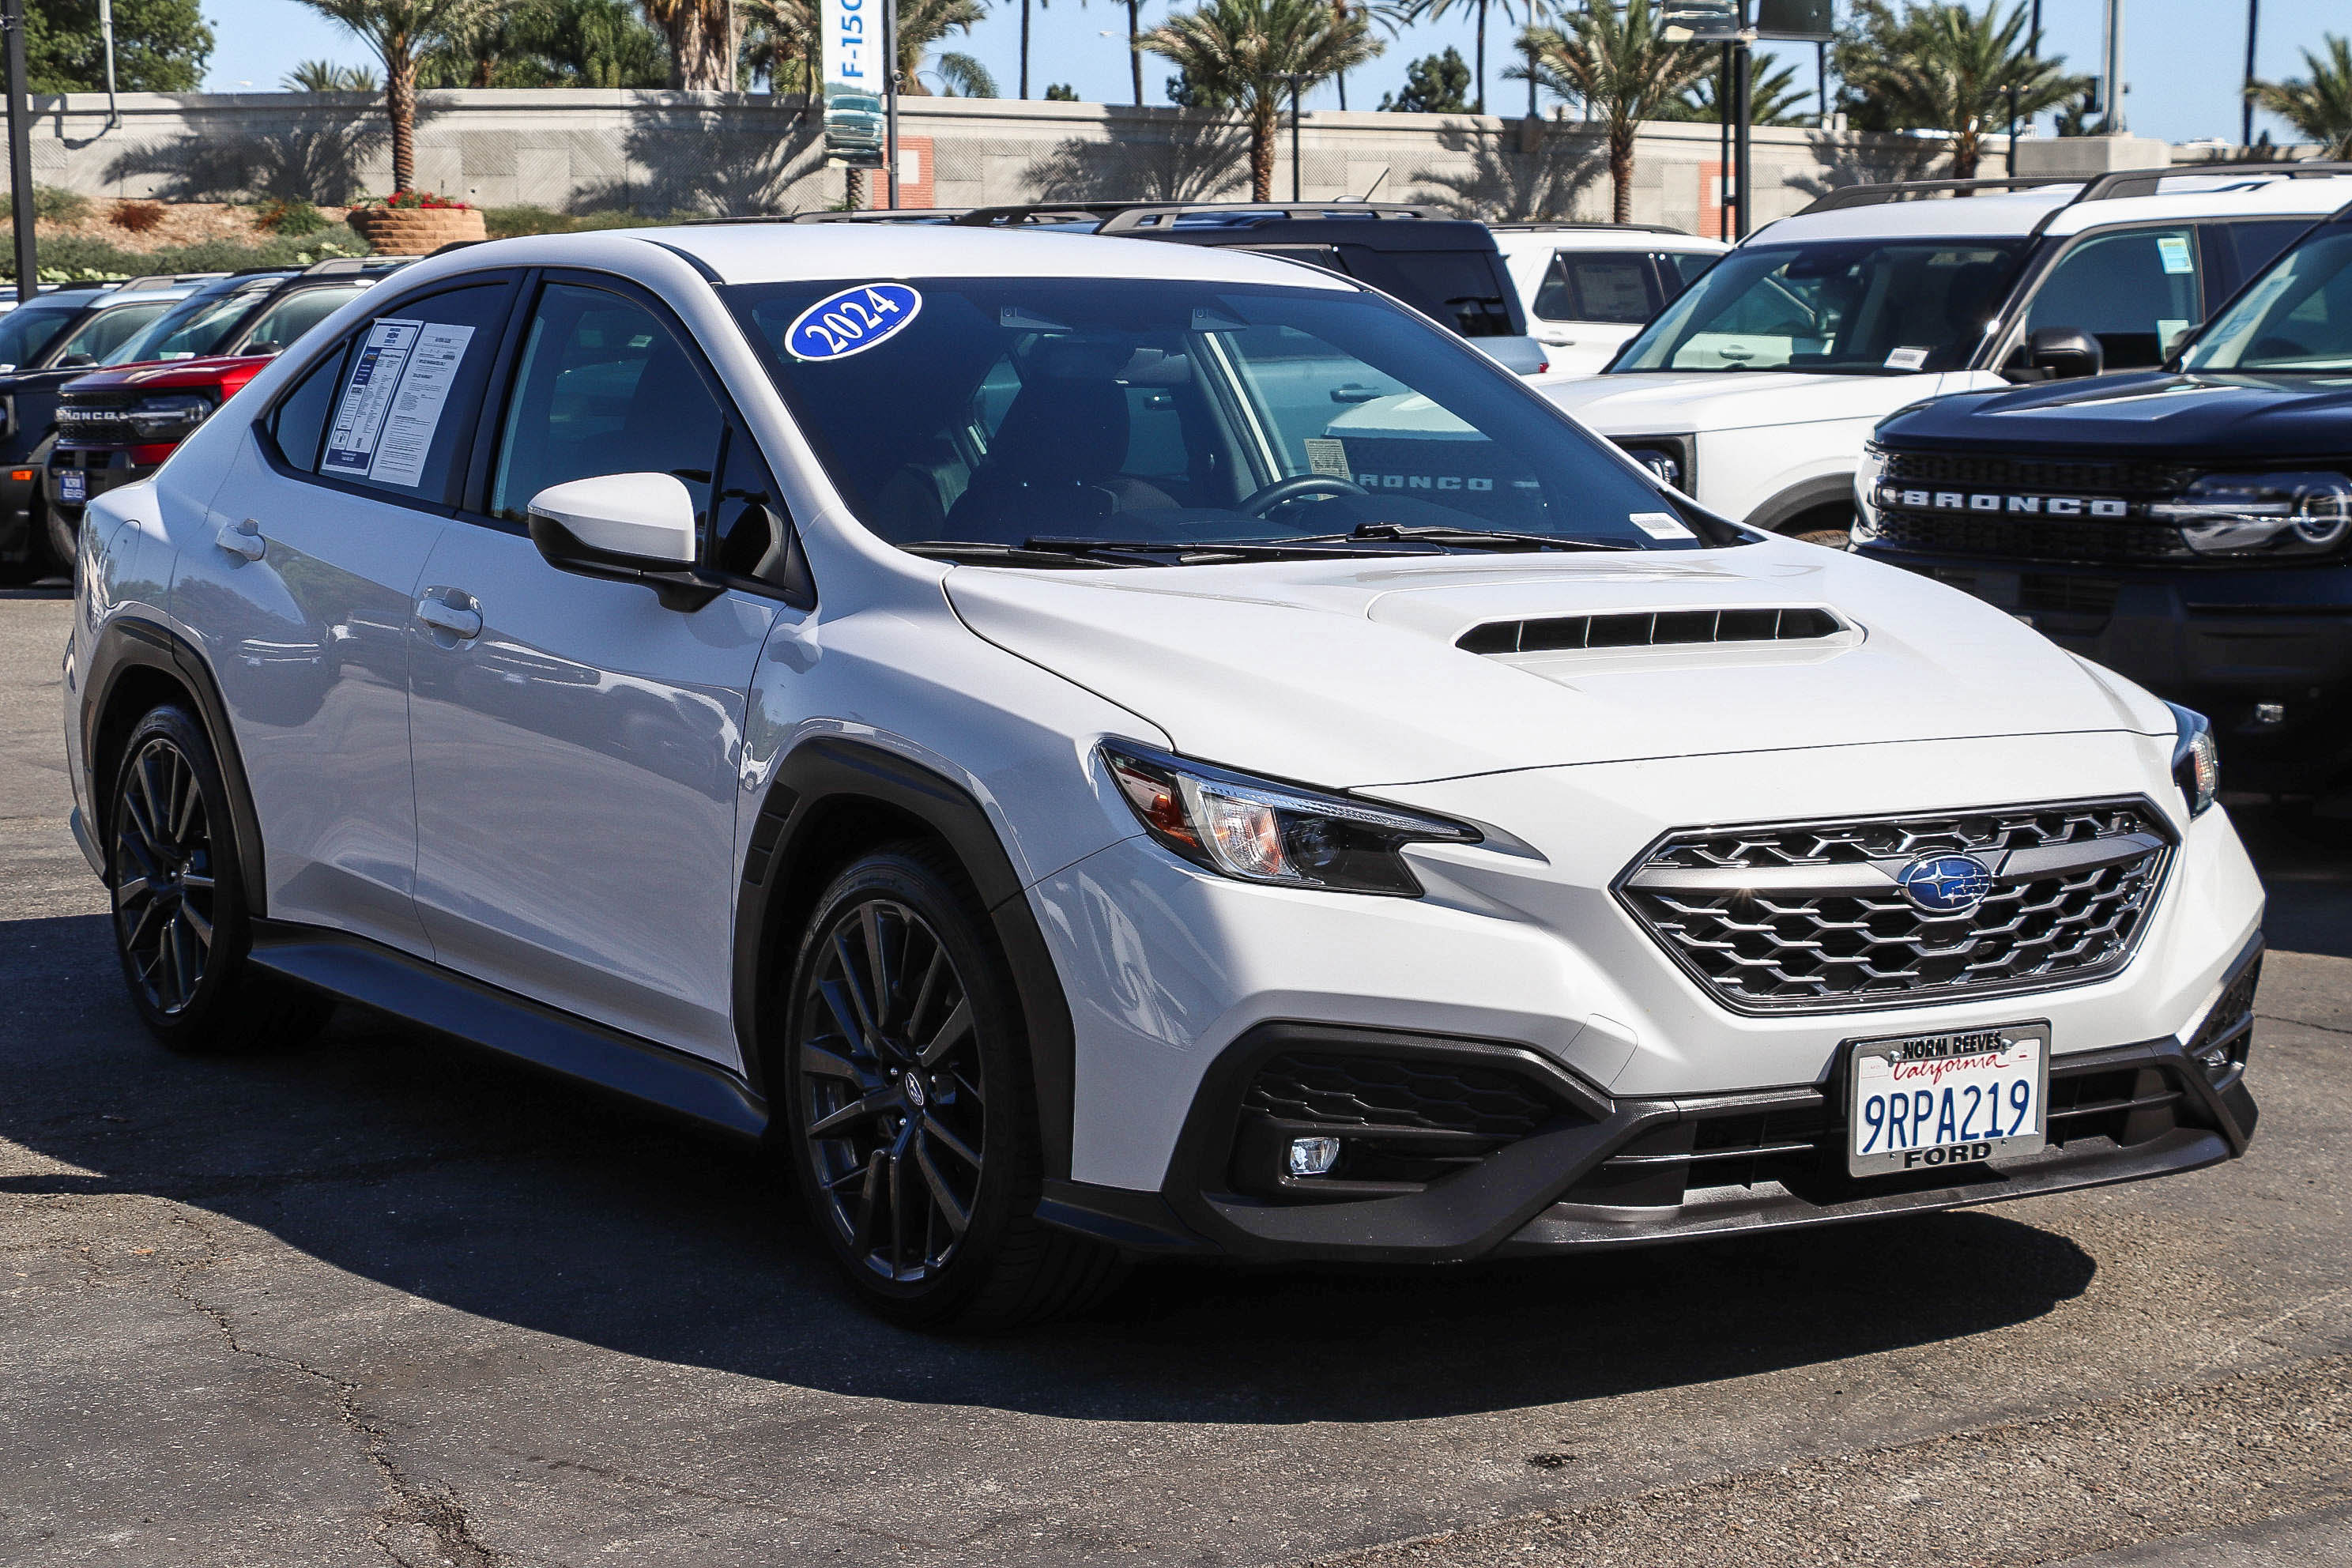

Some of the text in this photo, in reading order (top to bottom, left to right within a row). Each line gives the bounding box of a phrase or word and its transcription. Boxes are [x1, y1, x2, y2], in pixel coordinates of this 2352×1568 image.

[805, 288, 900, 354] 2024
[1359, 474, 1493, 491] RONCO
[1903, 490, 2127, 515] BRONCO
[1902, 1031, 2003, 1060] NORM REEVES
[1894, 1054, 2011, 1086] California
[1862, 1080, 2030, 1153] 9RPA219
[1904, 1142, 1992, 1169] FORD
